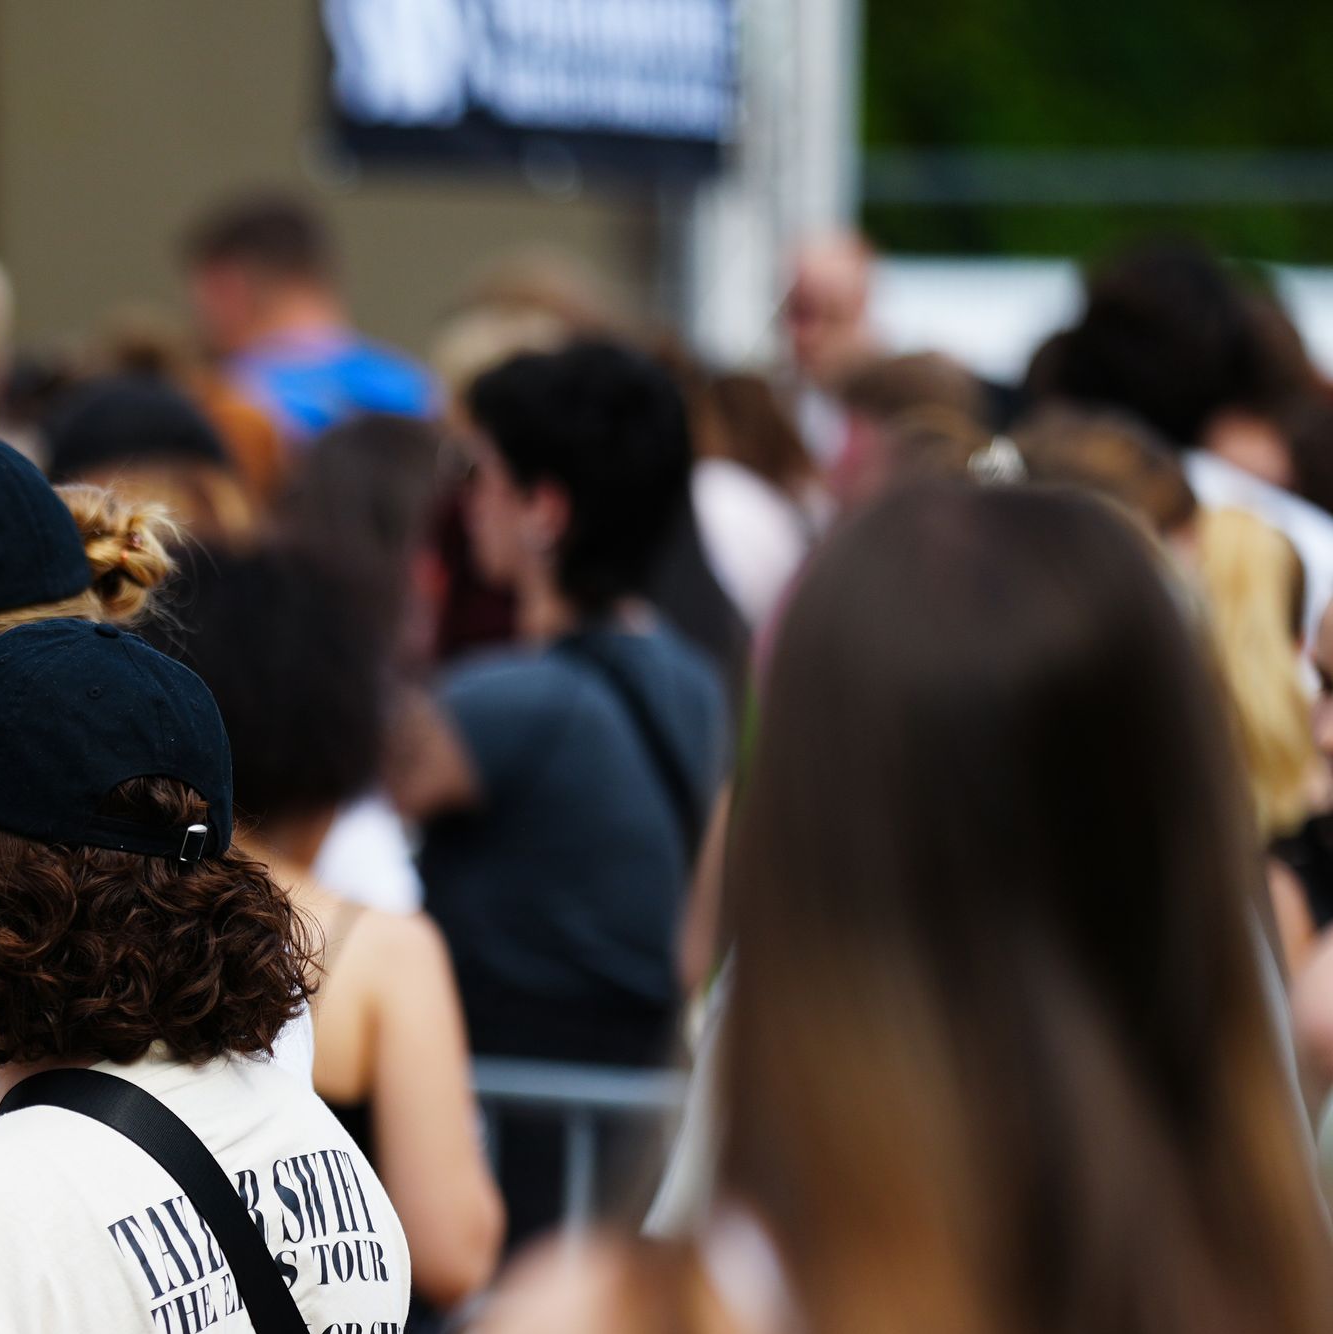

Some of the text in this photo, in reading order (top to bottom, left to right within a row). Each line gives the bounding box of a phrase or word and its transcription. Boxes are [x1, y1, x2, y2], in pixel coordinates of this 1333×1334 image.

[107, 1149, 377, 1301] TAYLR SWIFT
[311, 1240, 390, 1286] TOUR
